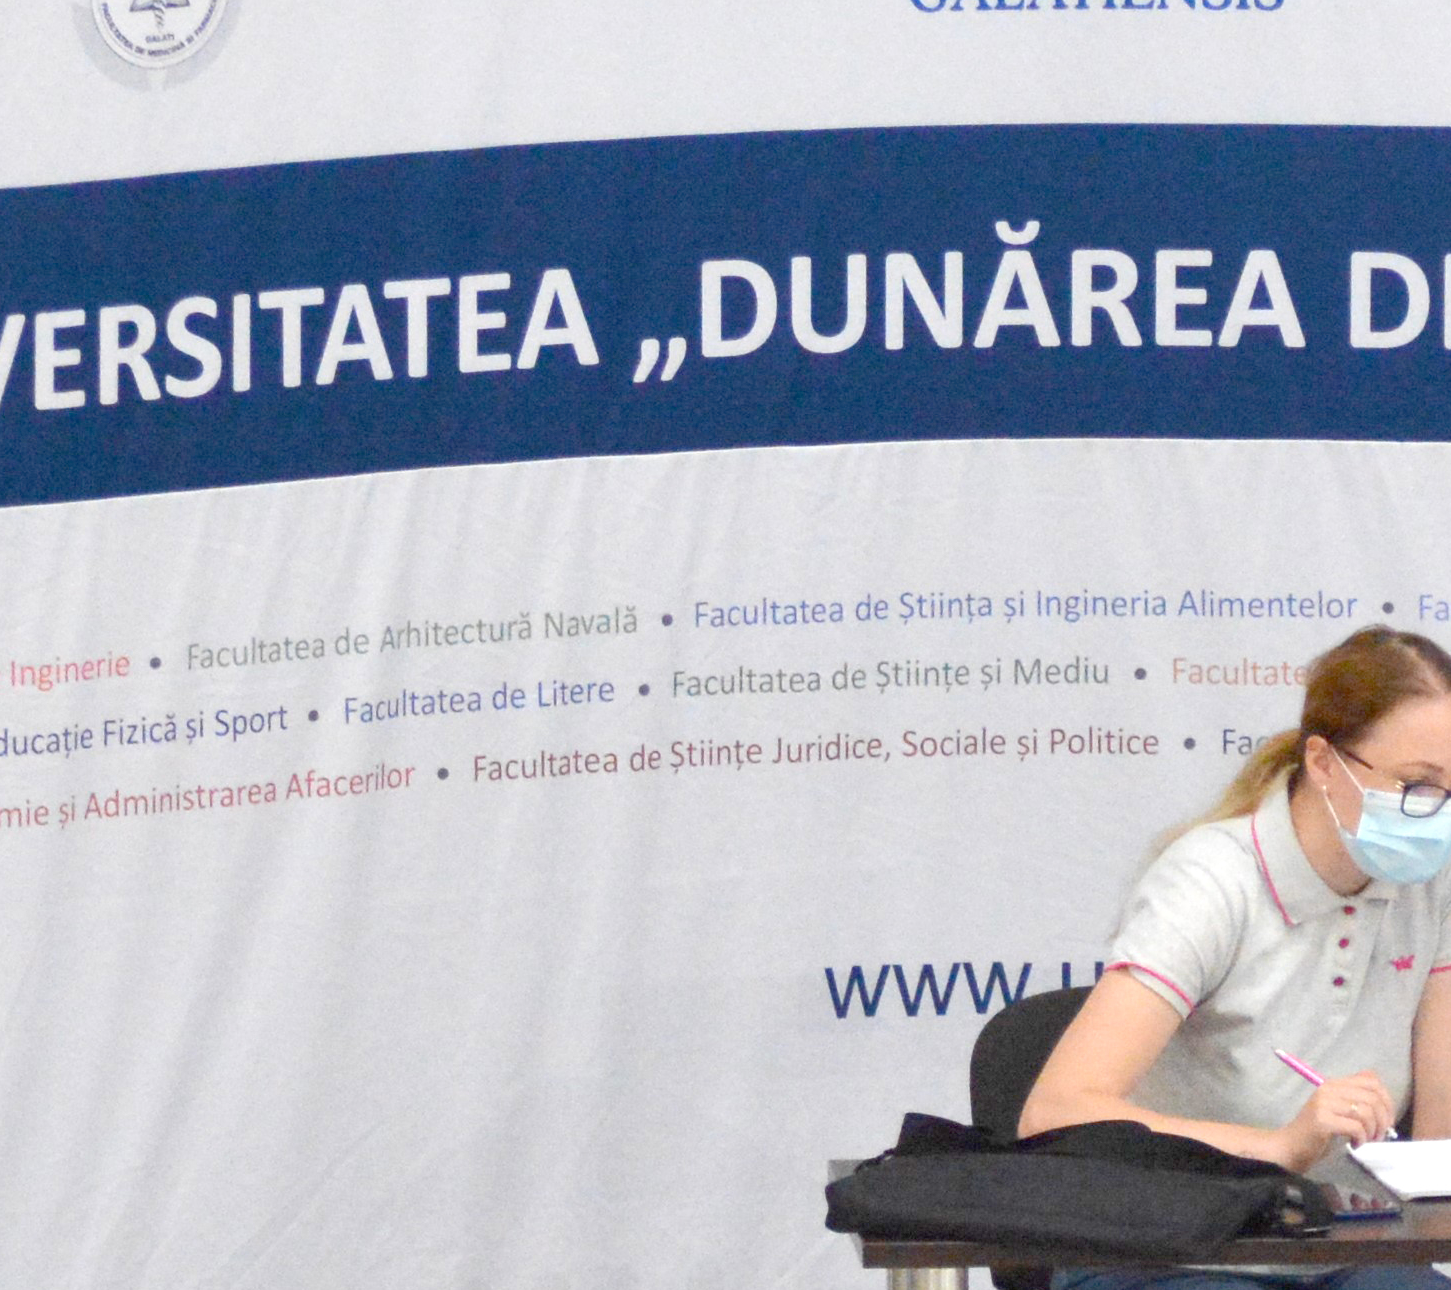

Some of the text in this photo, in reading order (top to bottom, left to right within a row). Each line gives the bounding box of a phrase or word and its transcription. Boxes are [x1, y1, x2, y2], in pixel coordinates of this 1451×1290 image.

[10, 655, 131, 692] Inginerie
[186, 637, 326, 671] Facultatea
[334, 627, 369, 656] de
[380, 612, 532, 652] Arhitectură
[544, 606, 638, 638] Navală
[694, 597, 844, 628] Facultatea
[854, 593, 889, 622] de
[899, 591, 993, 624] Știința
[1003, 591, 1025, 623] și
[1036, 589, 1167, 623] Ingineria
[1177, 589, 1357, 619] Alimentelor
[103, 714, 178, 746] Fizică
[185, 711, 204, 744] și
[214, 706, 287, 742] Sport
[344, 689, 482, 724] Facultatea
[491, 682, 526, 711] de
[537, 680, 615, 708] Litere
[671, 665, 821, 697] Facultatea
[831, 662, 867, 691] de
[876, 660, 970, 693] Științe
[980, 657, 1002, 691] și
[1013, 655, 1109, 685] Mediu
[1172, 657, 1310, 687] Facultate
[58, 795, 77, 830] și
[83, 781, 277, 819] Administrarea
[285, 762, 415, 799] Afacerilor
[473, 750, 618, 782] Facultatea
[629, 744, 662, 772] de
[670, 740, 763, 773] Științe
[772, 733, 891, 764] Juridice,
[902, 727, 1007, 758] Sociale
[1017, 728, 1038, 762] și
[1049, 726, 1159, 756] Politice
